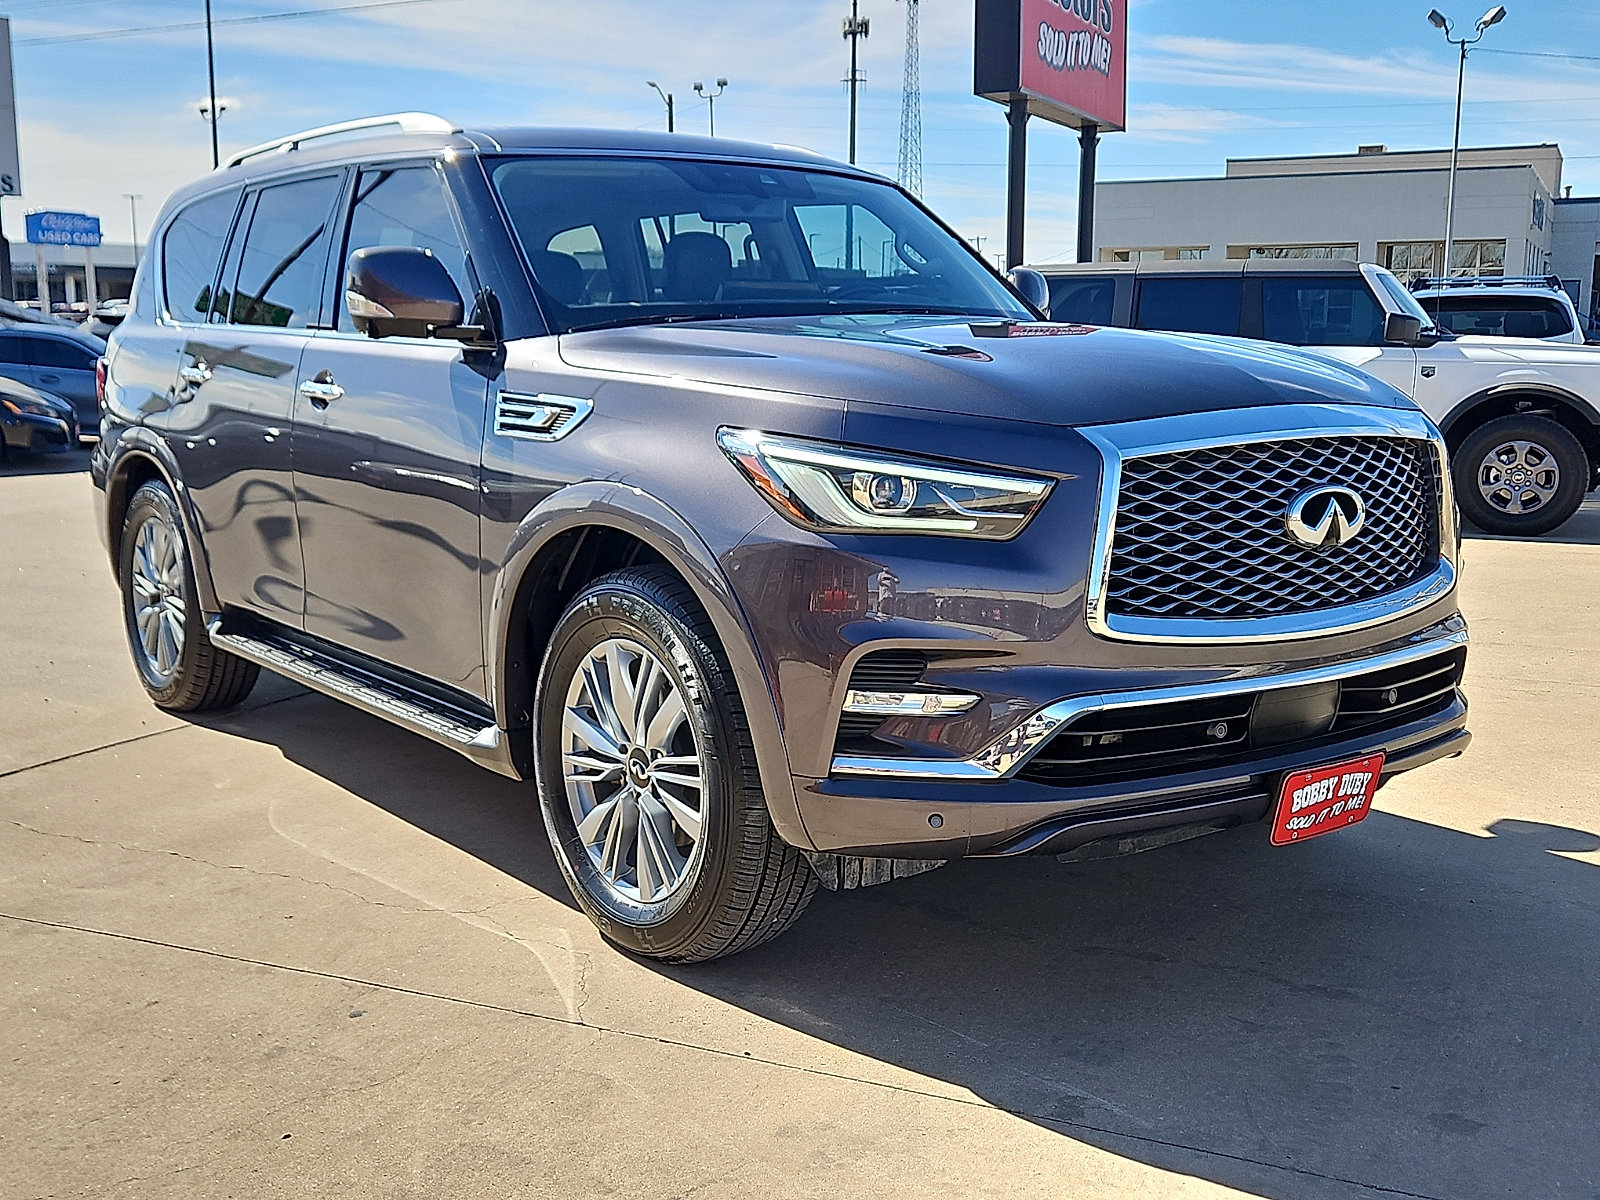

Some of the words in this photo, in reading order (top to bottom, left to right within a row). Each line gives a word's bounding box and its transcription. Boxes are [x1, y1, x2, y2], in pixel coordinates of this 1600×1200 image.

[1038, 22, 1067, 70] SOLD
[1066, 30, 1079, 69] IT
[1078, 30, 1091, 69] TO
[1091, 31, 1112, 77] ME!
[38, 230, 72, 243] USED
[72, 232, 99, 244] CARS
[1291, 776, 1339, 813] BOBBY
[1337, 772, 1373, 797] DUBY
[1285, 813, 1316, 830] SOLD
[1315, 807, 1332, 825] IT
[1330, 800, 1345, 818] TO
[1344, 795, 1366, 812] ME!
